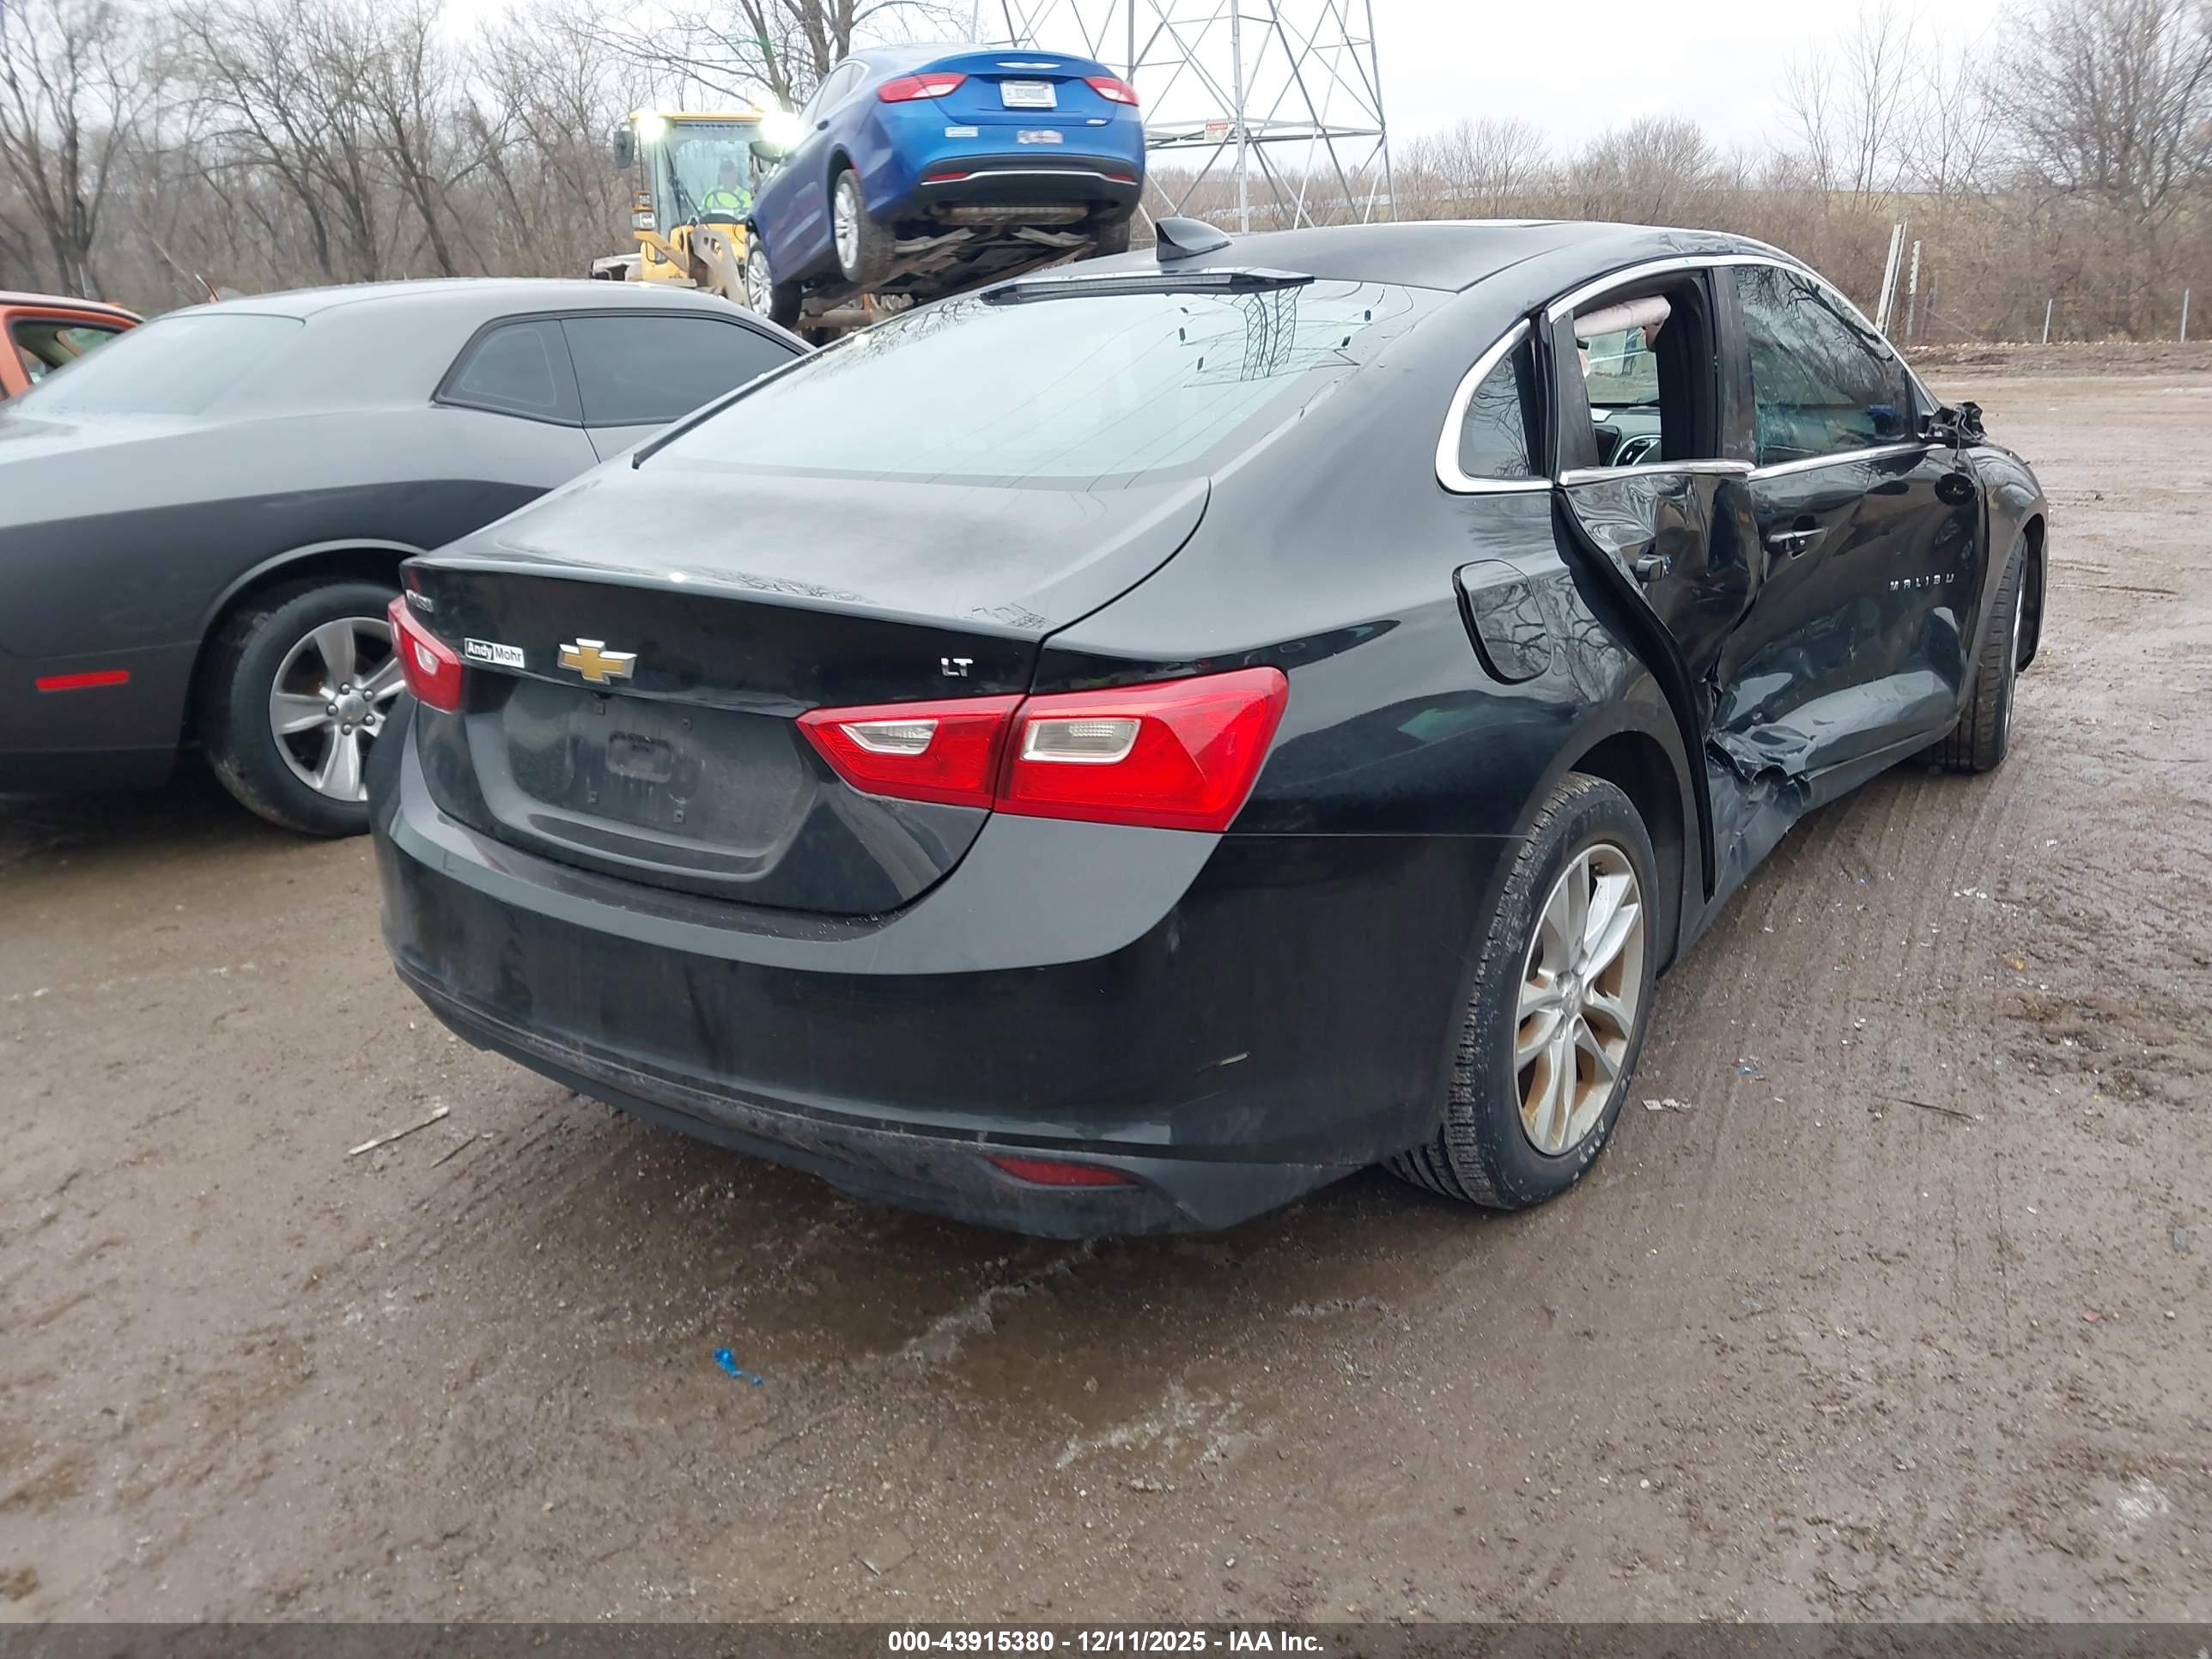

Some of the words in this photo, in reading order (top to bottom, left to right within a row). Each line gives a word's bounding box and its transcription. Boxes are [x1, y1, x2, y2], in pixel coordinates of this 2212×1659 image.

[1889, 573, 1954, 591] MALIBU
[467, 641, 493, 660] Andy
[495, 646, 522, 662] Mohr
[940, 658, 974, 677] LT
